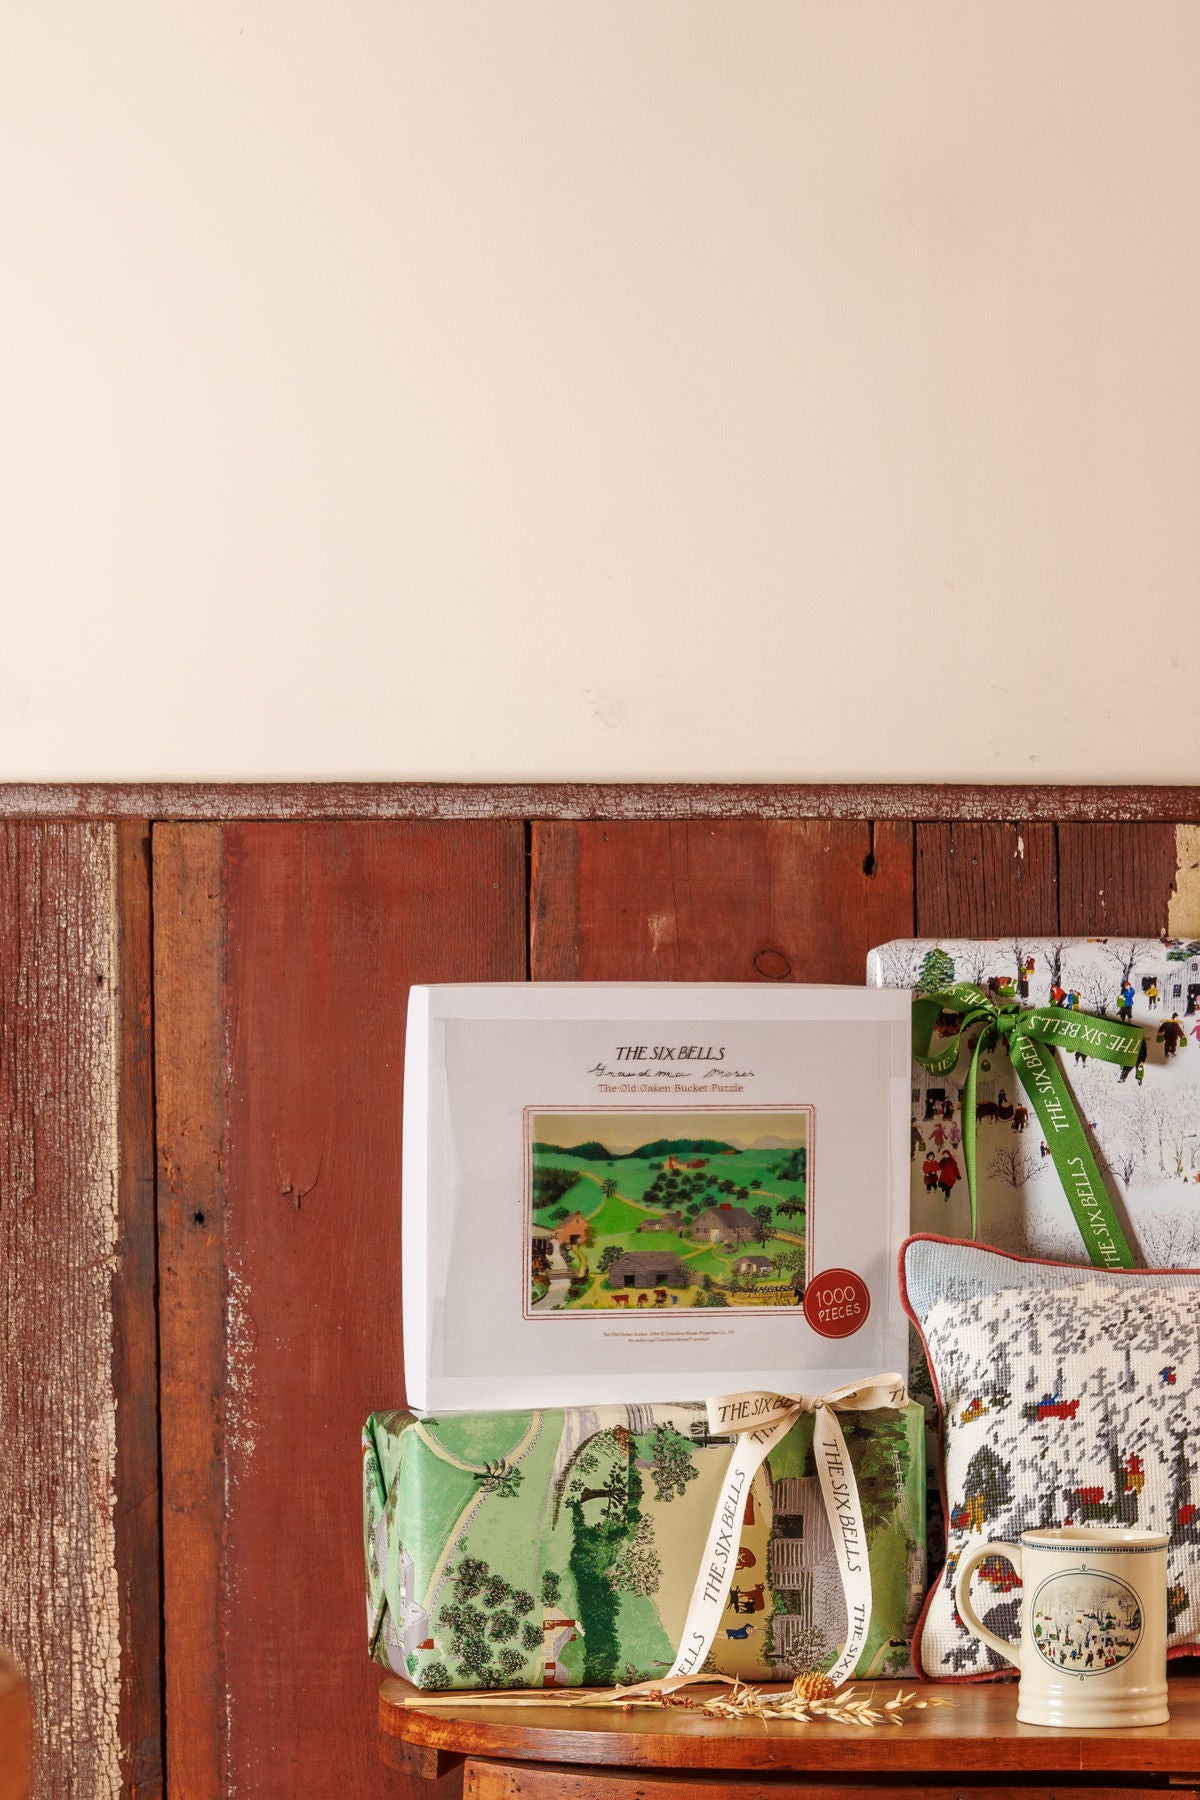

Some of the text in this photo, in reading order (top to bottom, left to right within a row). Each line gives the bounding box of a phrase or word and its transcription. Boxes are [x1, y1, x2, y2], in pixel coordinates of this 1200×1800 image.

[616, 1045, 727, 1061] THE SIX BELLS
[1028, 1015, 1142, 1055] THE SIX BELLS
[599, 1083, 744, 1093] The Old Oaken Bucket Puzzle
[1016, 1036, 1070, 1133] THE SIX BELL
[1067, 1156, 1124, 1270] THE SIX BELLS
[816, 1286, 856, 1307] 1000
[818, 1303, 861, 1322] PIECES
[718, 1402, 750, 1423] THE
[751, 1397, 773, 1416] SIX
[822, 1439, 863, 1573] THE SIX BELLS
[703, 1468, 745, 1604] THE SIX BELLS
[839, 1603, 866, 1669] THE SIX
